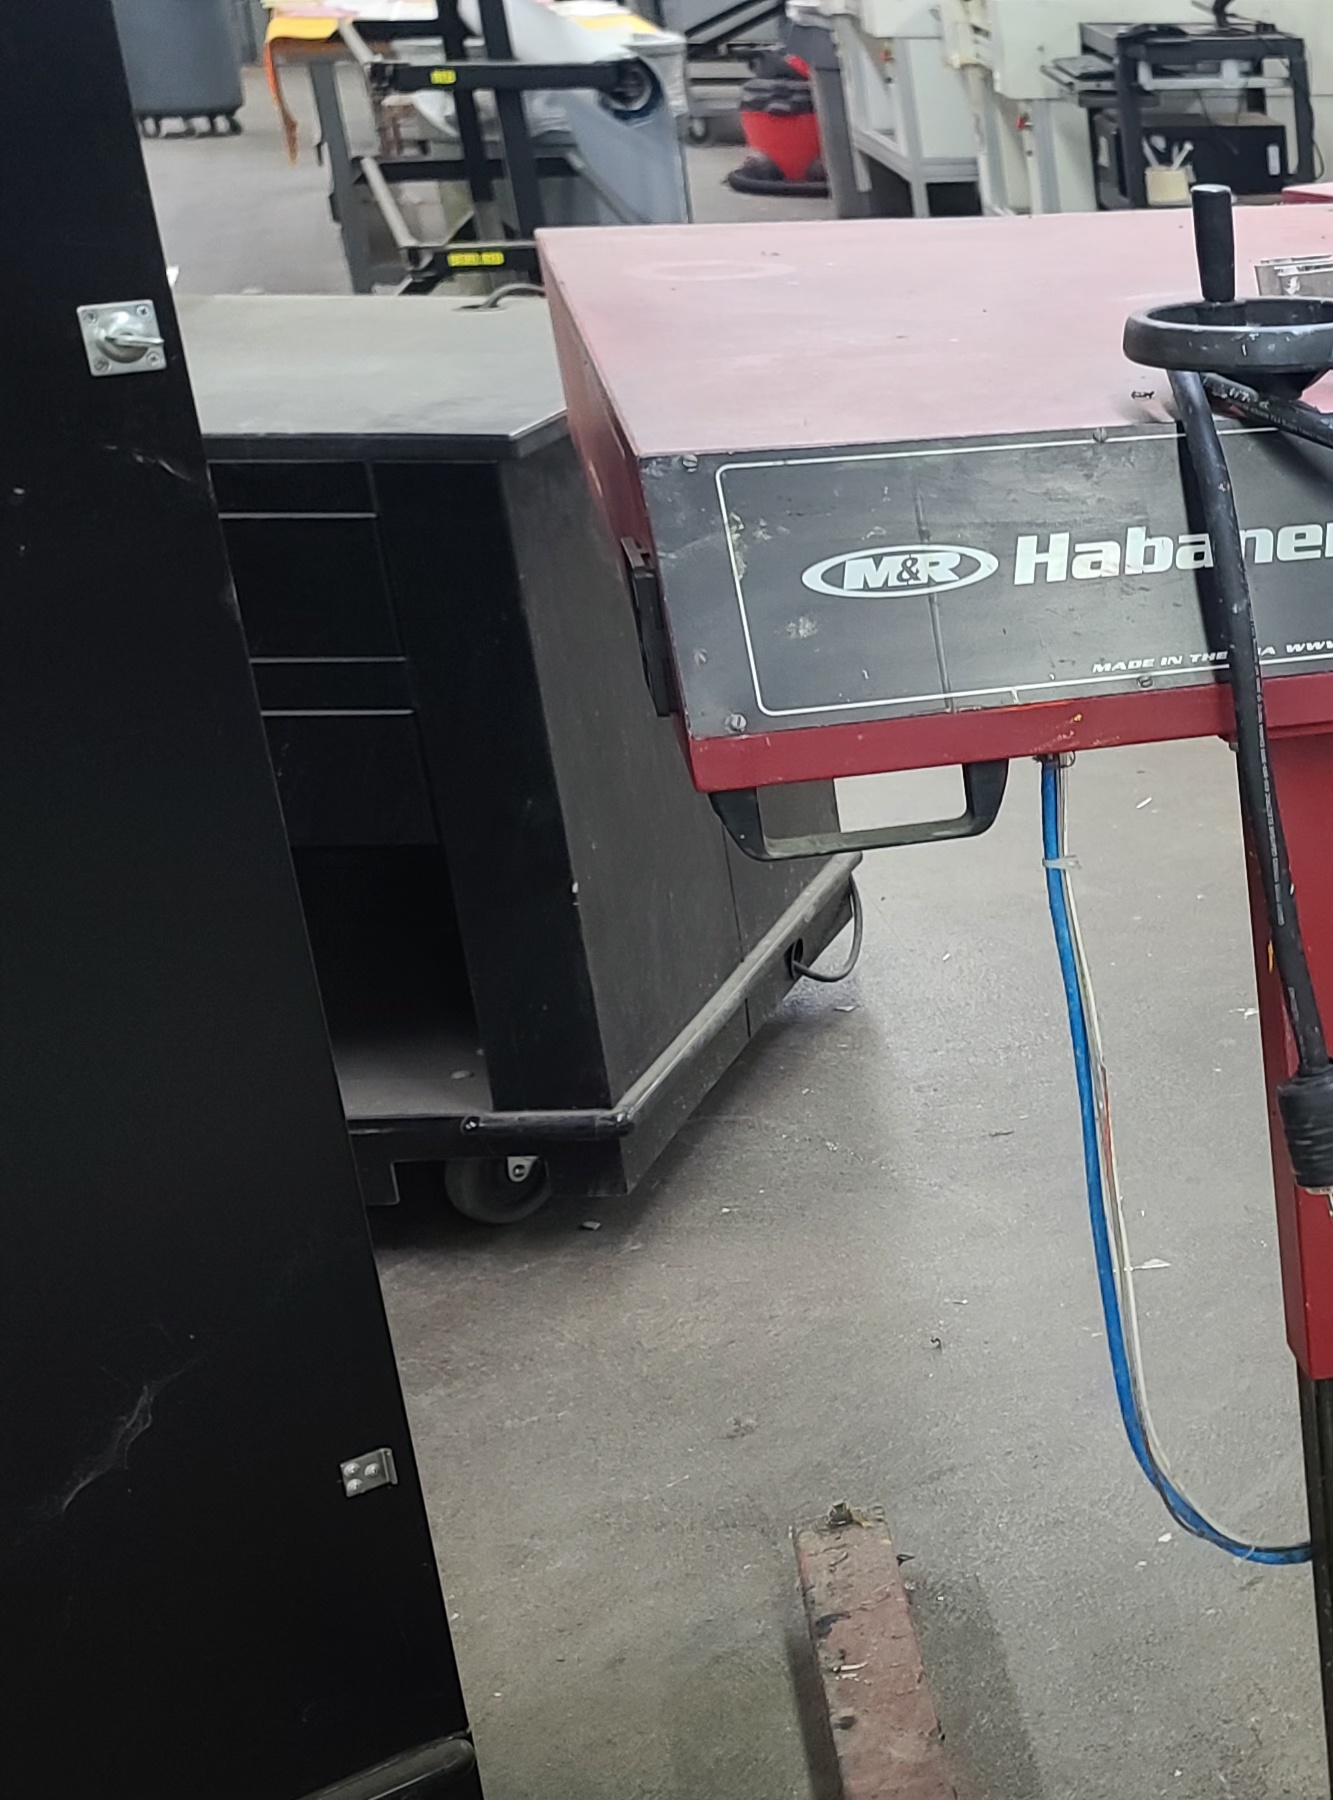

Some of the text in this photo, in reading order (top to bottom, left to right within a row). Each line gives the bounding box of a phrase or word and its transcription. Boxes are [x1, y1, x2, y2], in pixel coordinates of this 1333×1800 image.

[1092, 659, 1154, 674] MADE
[1160, 654, 1184, 667] IN
[1189, 650, 1229, 664] THE
